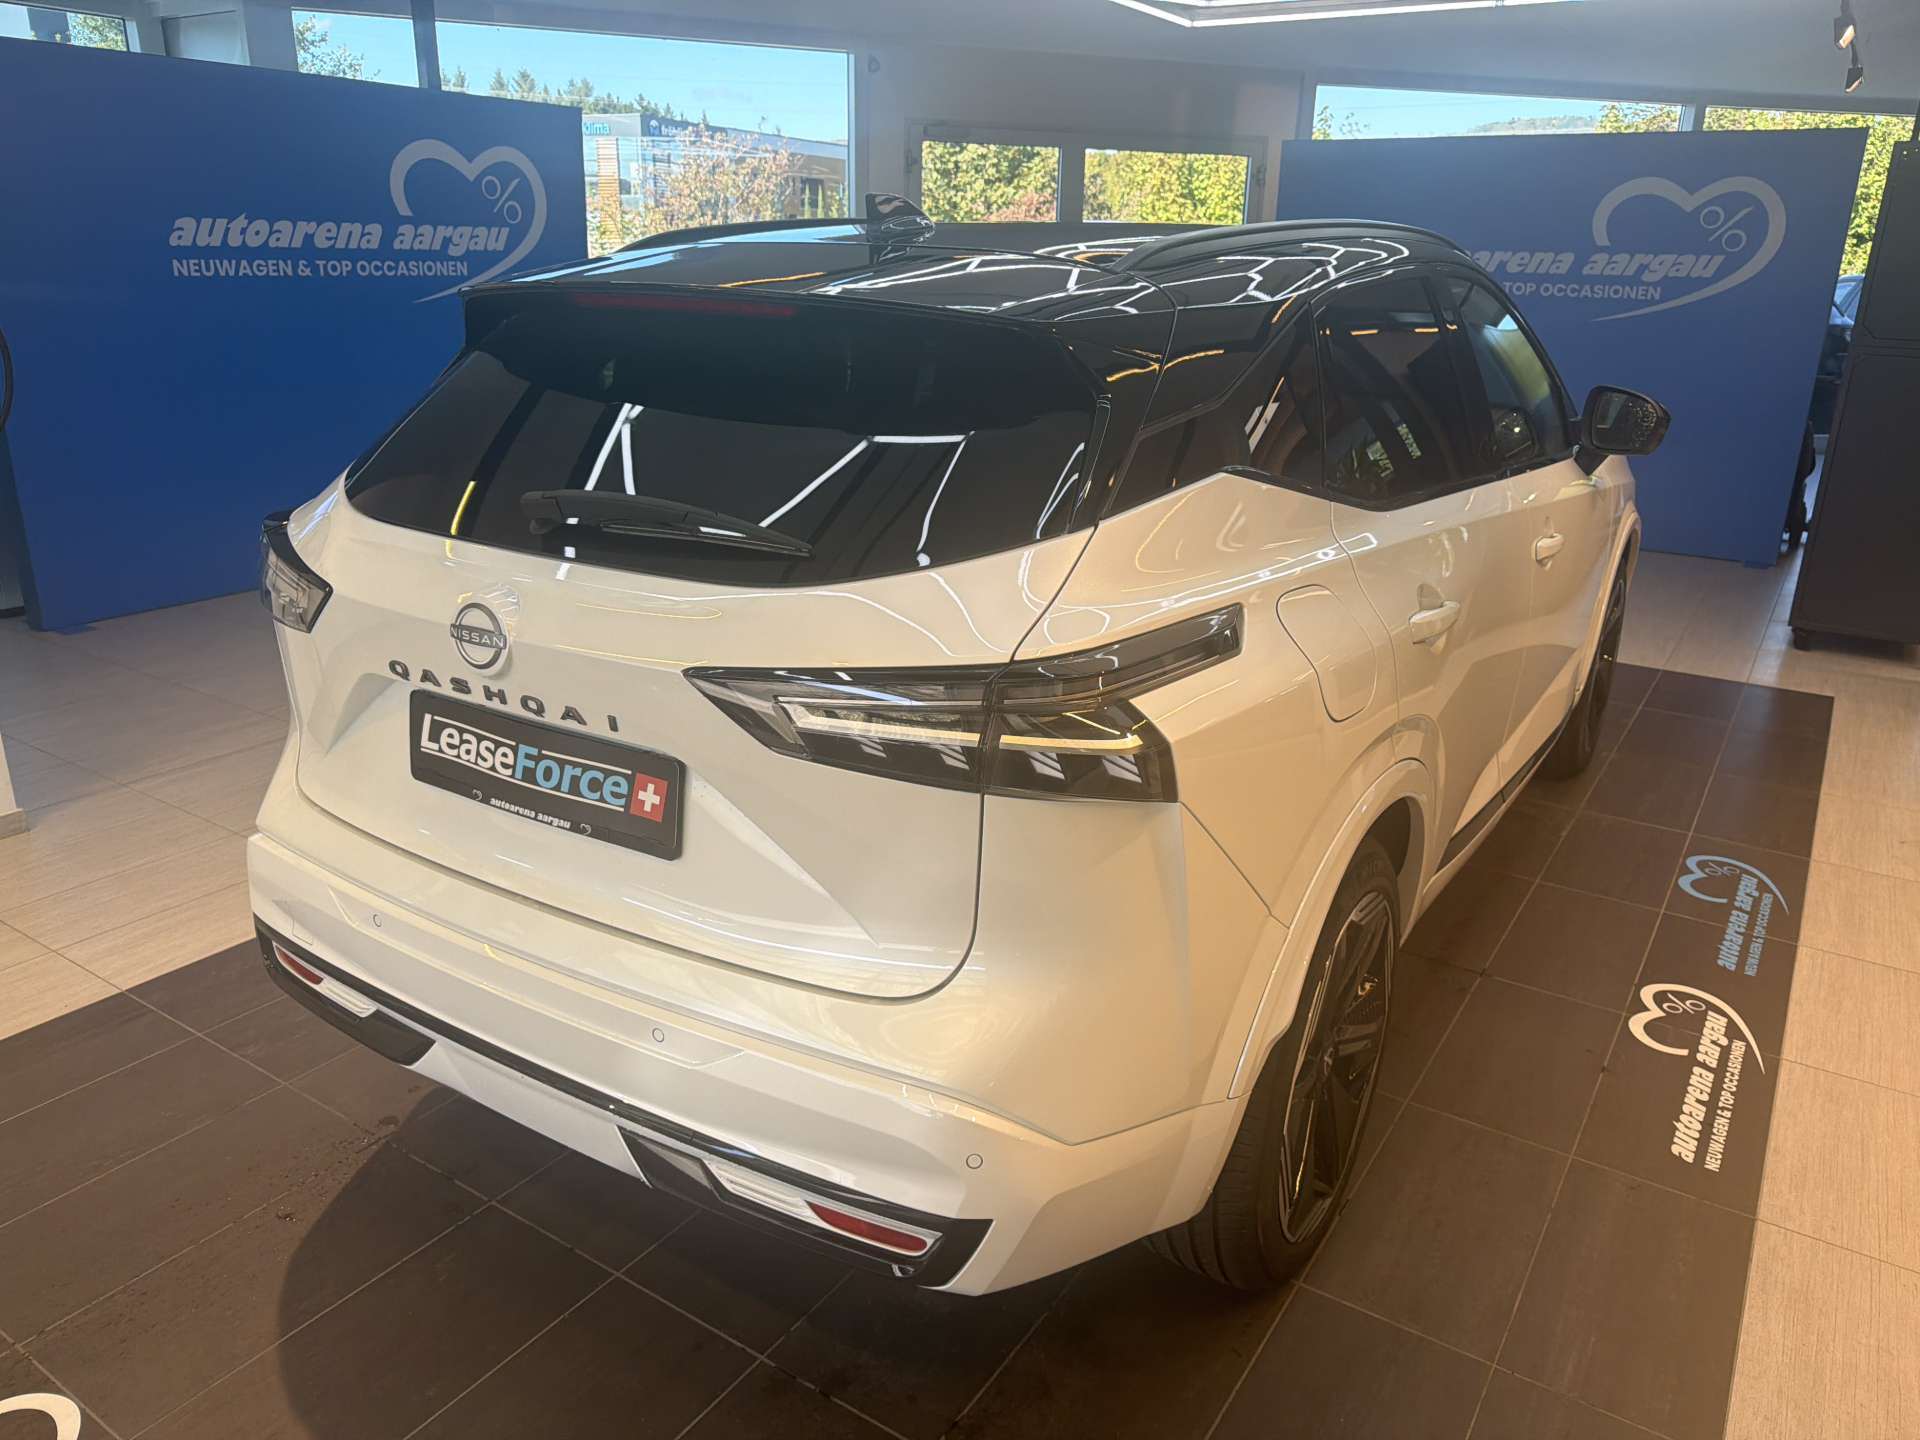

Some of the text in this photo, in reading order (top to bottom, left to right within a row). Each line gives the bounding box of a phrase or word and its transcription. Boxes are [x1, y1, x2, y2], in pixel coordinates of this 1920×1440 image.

[169, 213, 510, 257] autoarena aargau
[172, 259, 468, 277] NEUWAGEN & TOP OCCASIONEN
[1465, 250, 1726, 282] arena aargau
[1503, 281, 1661, 300] TOP OCCASIONEN
[450, 625, 505, 648] NISSAN
[388, 659, 619, 733] QASHQAI
[420, 712, 629, 807] LeaseForce
[490, 797, 571, 829] autoarena aargau
[1716, 874, 1760, 972] autoarena aargau
[1670, 1010, 1729, 1164] autoarena aargau
[1703, 1038, 1747, 1173] NEUWAGEN & TOP OCCASIONEN
